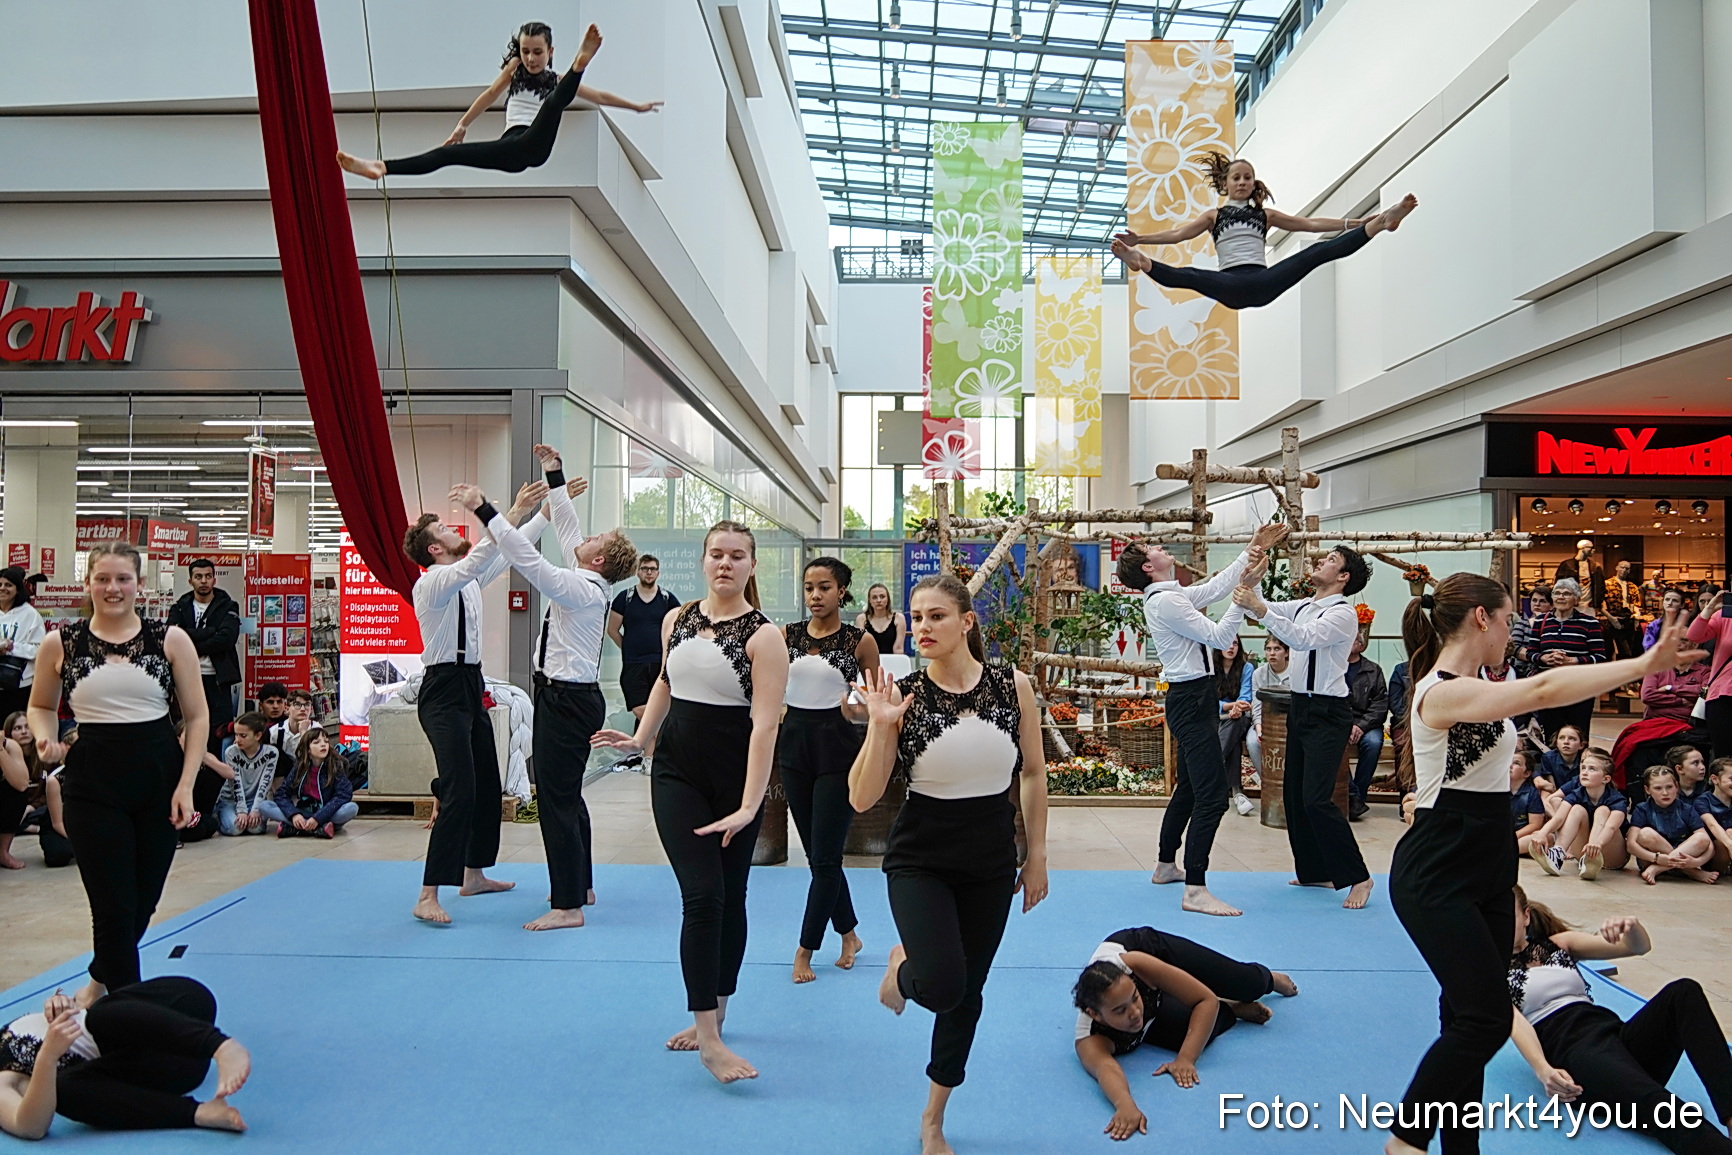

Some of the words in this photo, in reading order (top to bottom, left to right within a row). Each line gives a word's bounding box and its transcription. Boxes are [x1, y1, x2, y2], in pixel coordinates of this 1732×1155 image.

[0, 280, 152, 362] arkt
[76, 524, 123, 538] artbar
[154, 525, 188, 541] Smartbar
[911, 549, 927, 560] Ich
[911, 561, 931, 571] den
[249, 575, 304, 585] Vorbesteller
[345, 568, 367, 582] für
[345, 586, 361, 595] hier
[362, 587, 371, 595] im
[350, 603, 399, 613] Displayschutz
[350, 615, 400, 624] Displaytausch
[350, 626, 391, 635] Akkutausch
[350, 638, 364, 646] und
[365, 638, 386, 646] vieles
[387, 638, 407, 646] mehr
